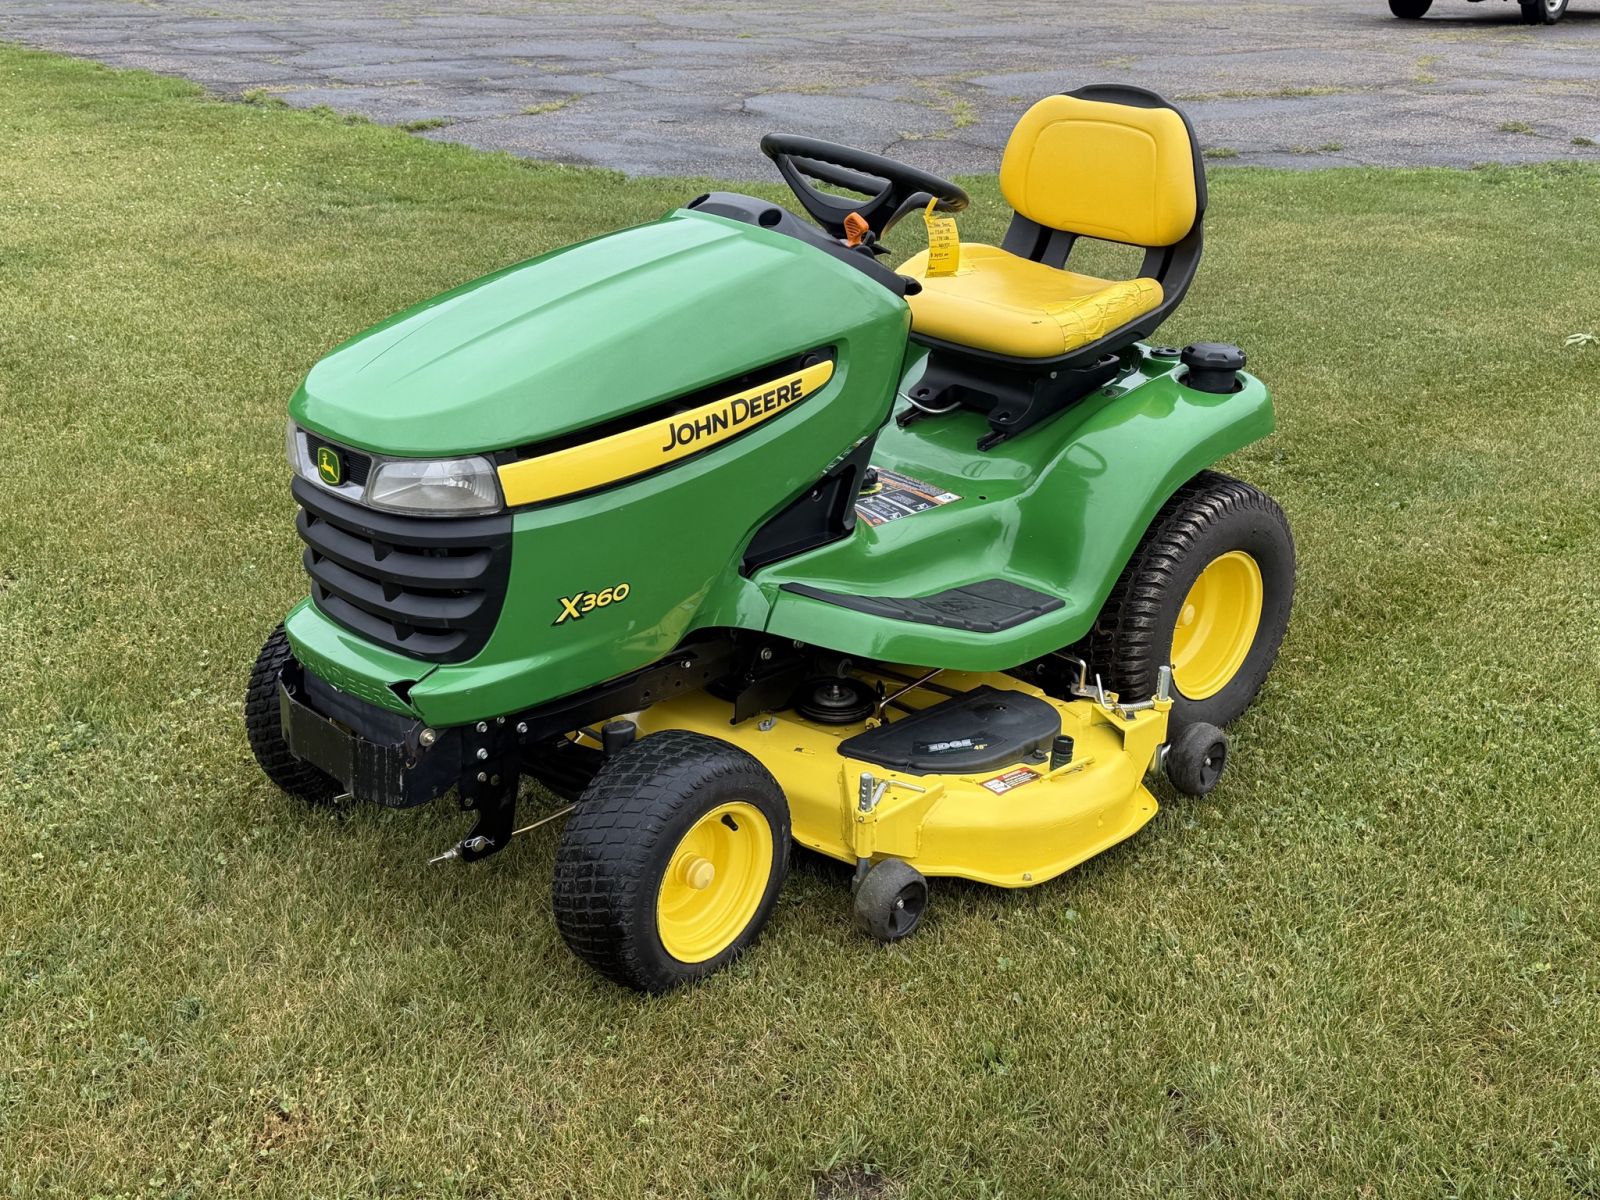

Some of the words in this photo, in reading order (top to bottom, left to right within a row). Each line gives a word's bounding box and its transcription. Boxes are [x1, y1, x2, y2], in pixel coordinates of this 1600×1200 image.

[662, 409, 729, 452] JOHN
[730, 378, 803, 426] DEERE
[552, 582, 631, 626] X360
[927, 738, 972, 753] EDGE
